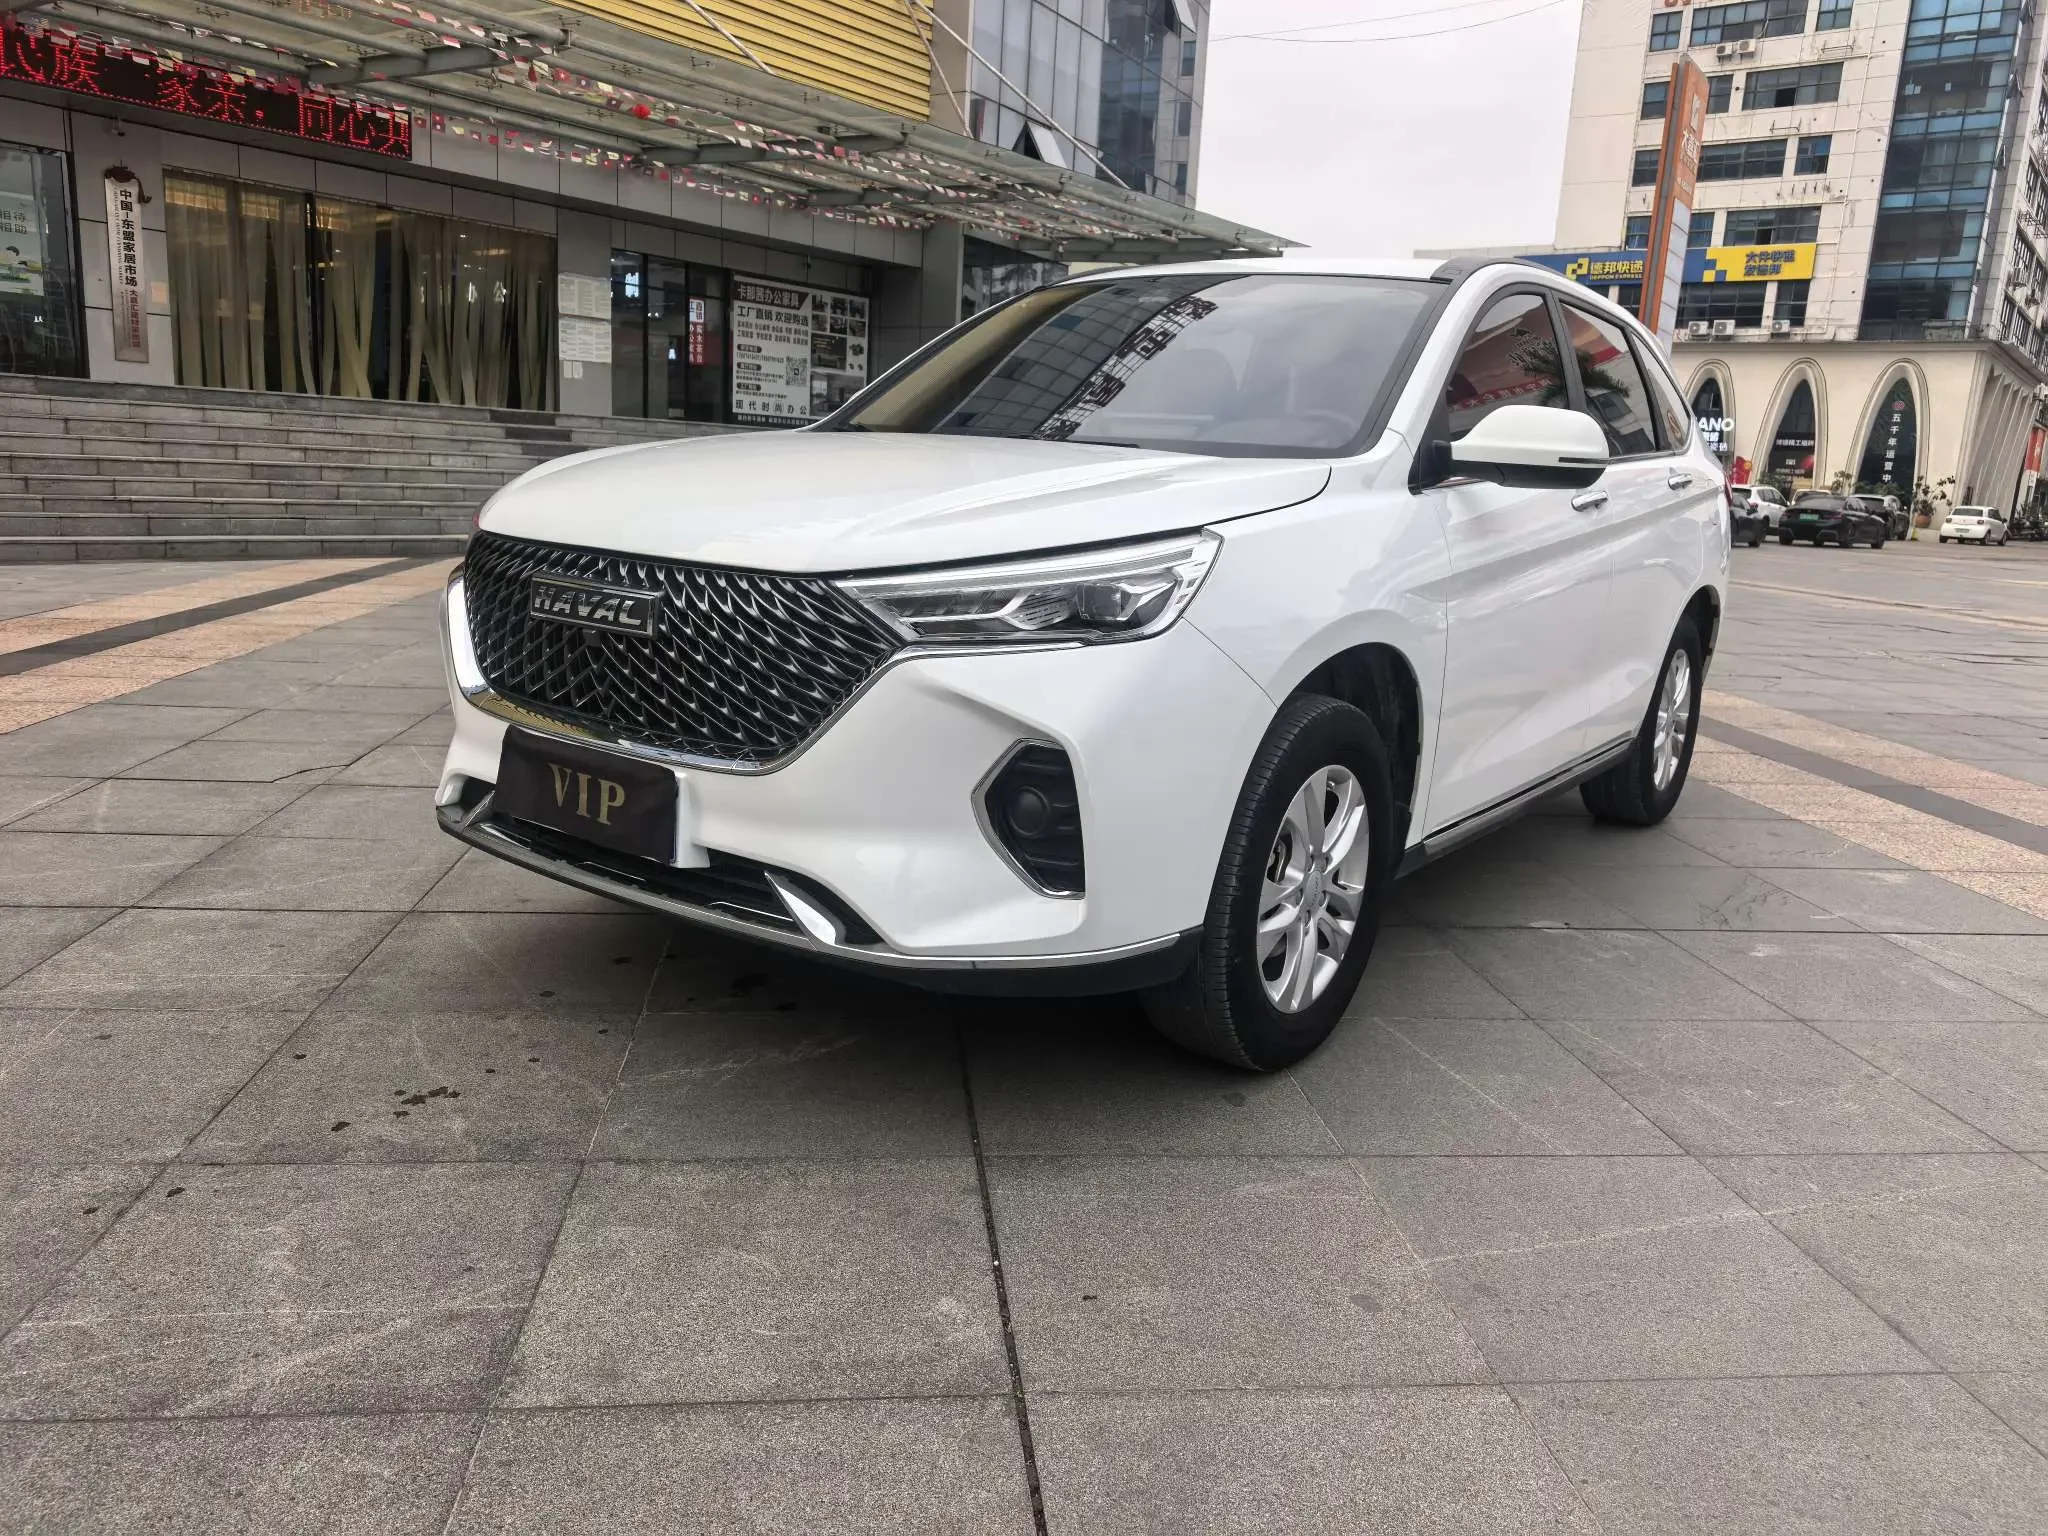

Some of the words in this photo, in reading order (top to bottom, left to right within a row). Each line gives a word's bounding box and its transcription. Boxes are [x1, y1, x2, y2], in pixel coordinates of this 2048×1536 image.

[1590, 260, 1643, 275] 德邦快递
[1696, 416, 1735, 432] ANO
[533, 585, 644, 627] HAVAL
[547, 761, 627, 827] VIP
